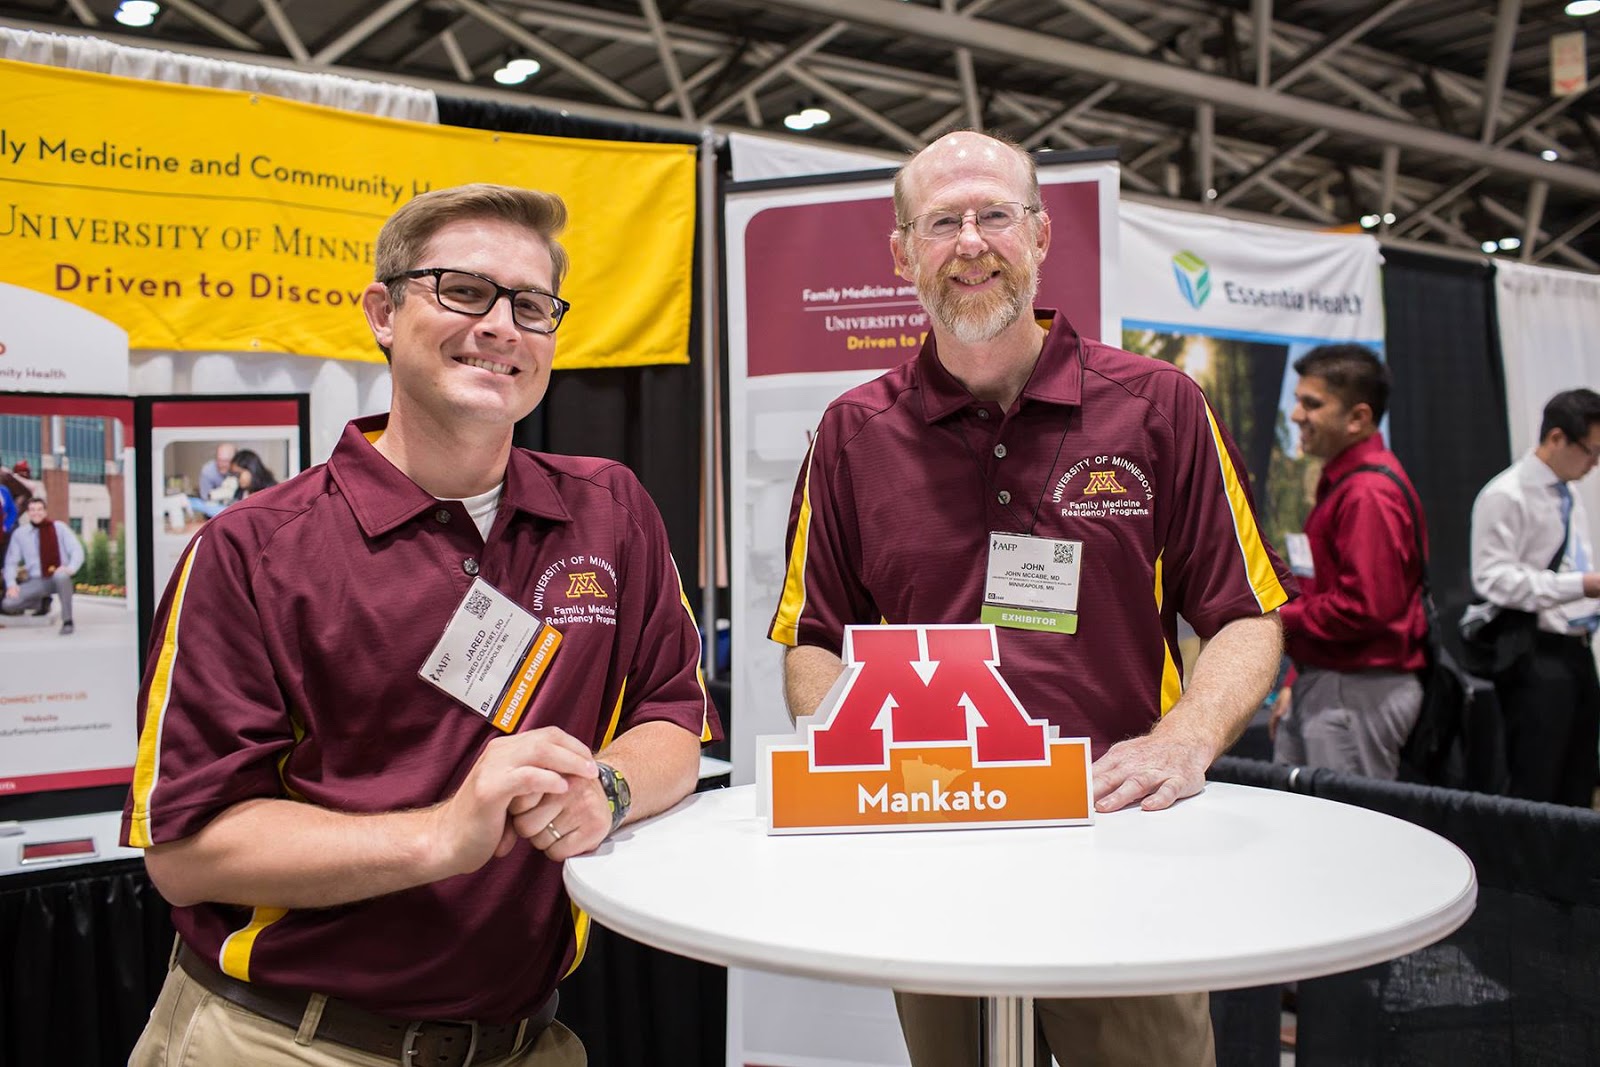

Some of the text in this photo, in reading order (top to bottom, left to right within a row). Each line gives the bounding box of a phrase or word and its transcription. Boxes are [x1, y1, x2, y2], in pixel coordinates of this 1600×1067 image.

[39, 136, 180, 173] Medicine
[190, 153, 241, 176] and
[251, 155, 403, 204] Community
[221, 227, 261, 251] OF
[55, 263, 182, 298] Driven
[198, 273, 235, 298] to
[802, 287, 841, 303] Family
[842, 285, 895, 299] Medicine
[1223, 280, 1304, 311] Essentia
[825, 314, 907, 331] UNIVERSITY
[847, 336, 897, 350] Driven
[900, 333, 917, 347] to
[26, 367, 66, 379] Health
[1053, 455, 1154, 503] UNIVERSITY OF MINNESOTA
[1061, 507, 1149, 517] Residency Programs
[1069, 499, 1141, 511] Family Medicine
[997, 542, 1018, 552] AAFP
[1020, 562, 1045, 572] JOHN
[533, 558, 566, 611] UNIVERSITY
[570, 555, 585, 565] OF
[545, 615, 593, 626] Residency
[553, 605, 585, 616] Family
[1001, 613, 1057, 626] EXHIBITOR
[465, 618, 504, 684] JARED COLVERT, DO
[467, 629, 486, 661] JARED
[435, 652, 451, 678] AAFP
[479, 643, 503, 682] MINNEAPOLIS,
[501, 633, 510, 643] MN
[500, 681, 528, 727] RESIDENT
[524, 633, 556, 681] EXHIBITOR
[22, 714, 58, 723] Website
[857, 779, 1007, 814] Mankato
